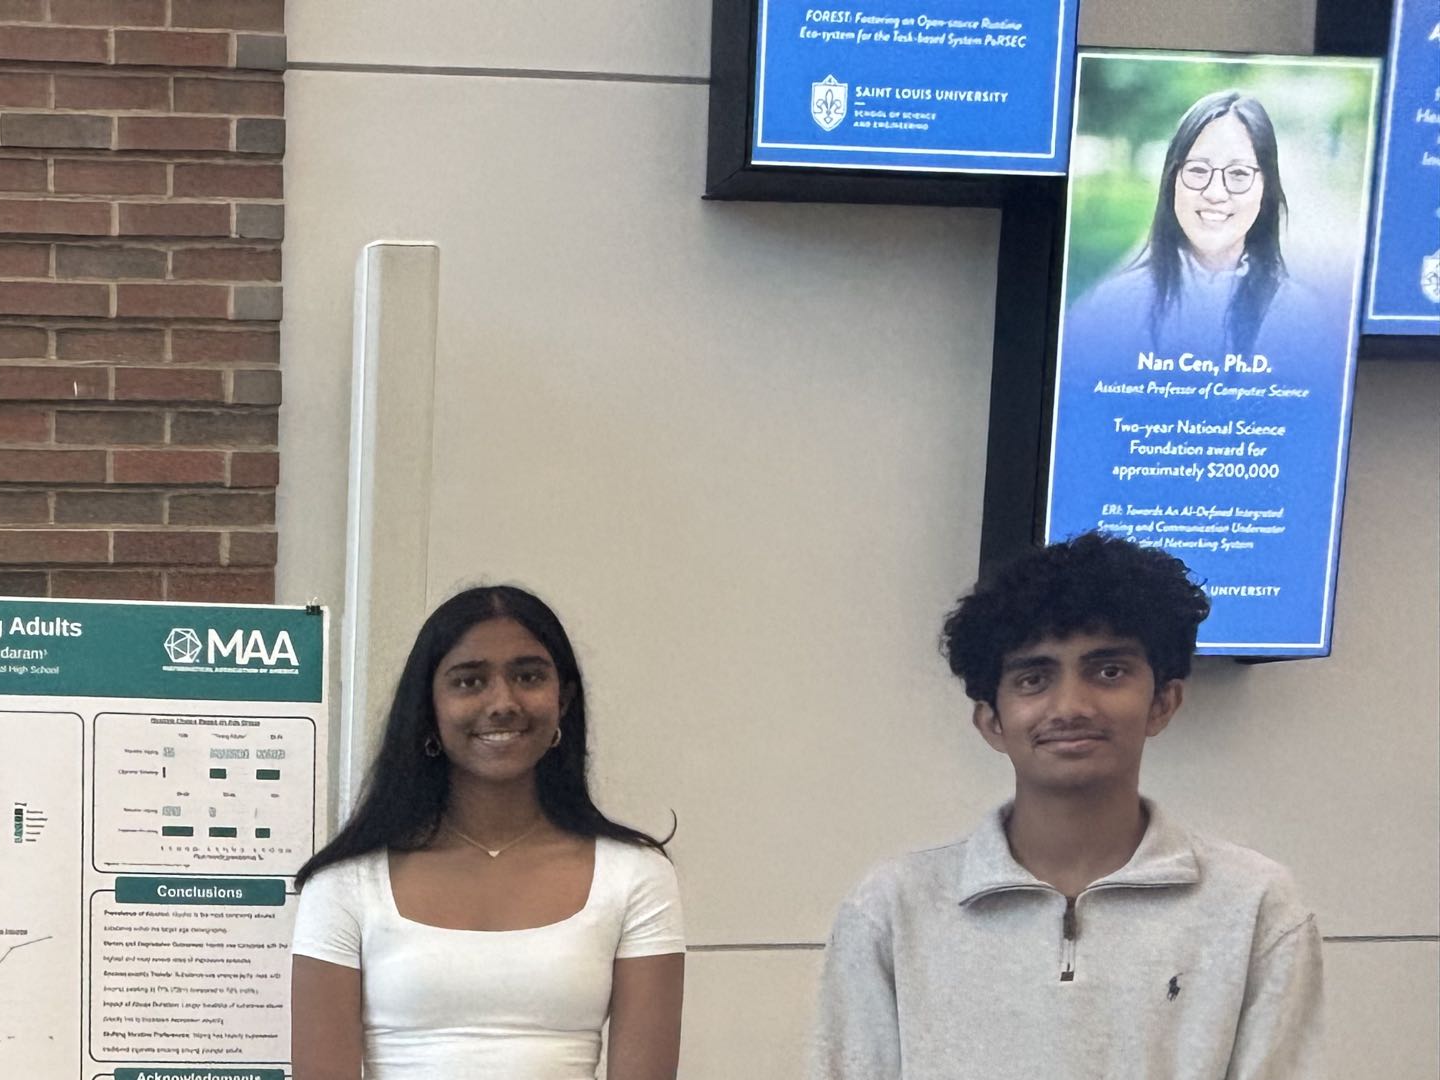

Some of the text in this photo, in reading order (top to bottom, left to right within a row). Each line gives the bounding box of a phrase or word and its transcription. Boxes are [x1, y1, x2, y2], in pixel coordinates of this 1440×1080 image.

[856, 29, 872, 43] for
[873, 30, 890, 42] the
[947, 33, 982, 48] System
[855, 86, 1008, 102] SAINT LOUIS UNIVERSITY
[854, 110, 937, 120] SCHOOL OF SCIENCE
[1138, 352, 1272, 375] Nan Cen, Ph.D.
[1094, 381, 1309, 399] Assistant Professor of Computer Science
[1114, 418, 1286, 437] Two-year National Science
[1130, 440, 1267, 457] Foundation award for
[1112, 462, 1279, 481] approximately $200,000
[1126, 504, 1163, 516] Towards
[1165, 506, 1179, 516] An
[1135, 521, 1154, 532] and
[1156, 521, 1229, 533] Communication
[1231, 523, 1286, 534] Underwater
[1164, 537, 1218, 552] Networking
[1221, 538, 1254, 552] System
[1211, 586, 1280, 596] UNIVERSITY
[9, 616, 82, 637] Adults
[207, 628, 299, 666] MAA
[30, 665, 59, 675] School
[157, 885, 243, 899] Conclusions
